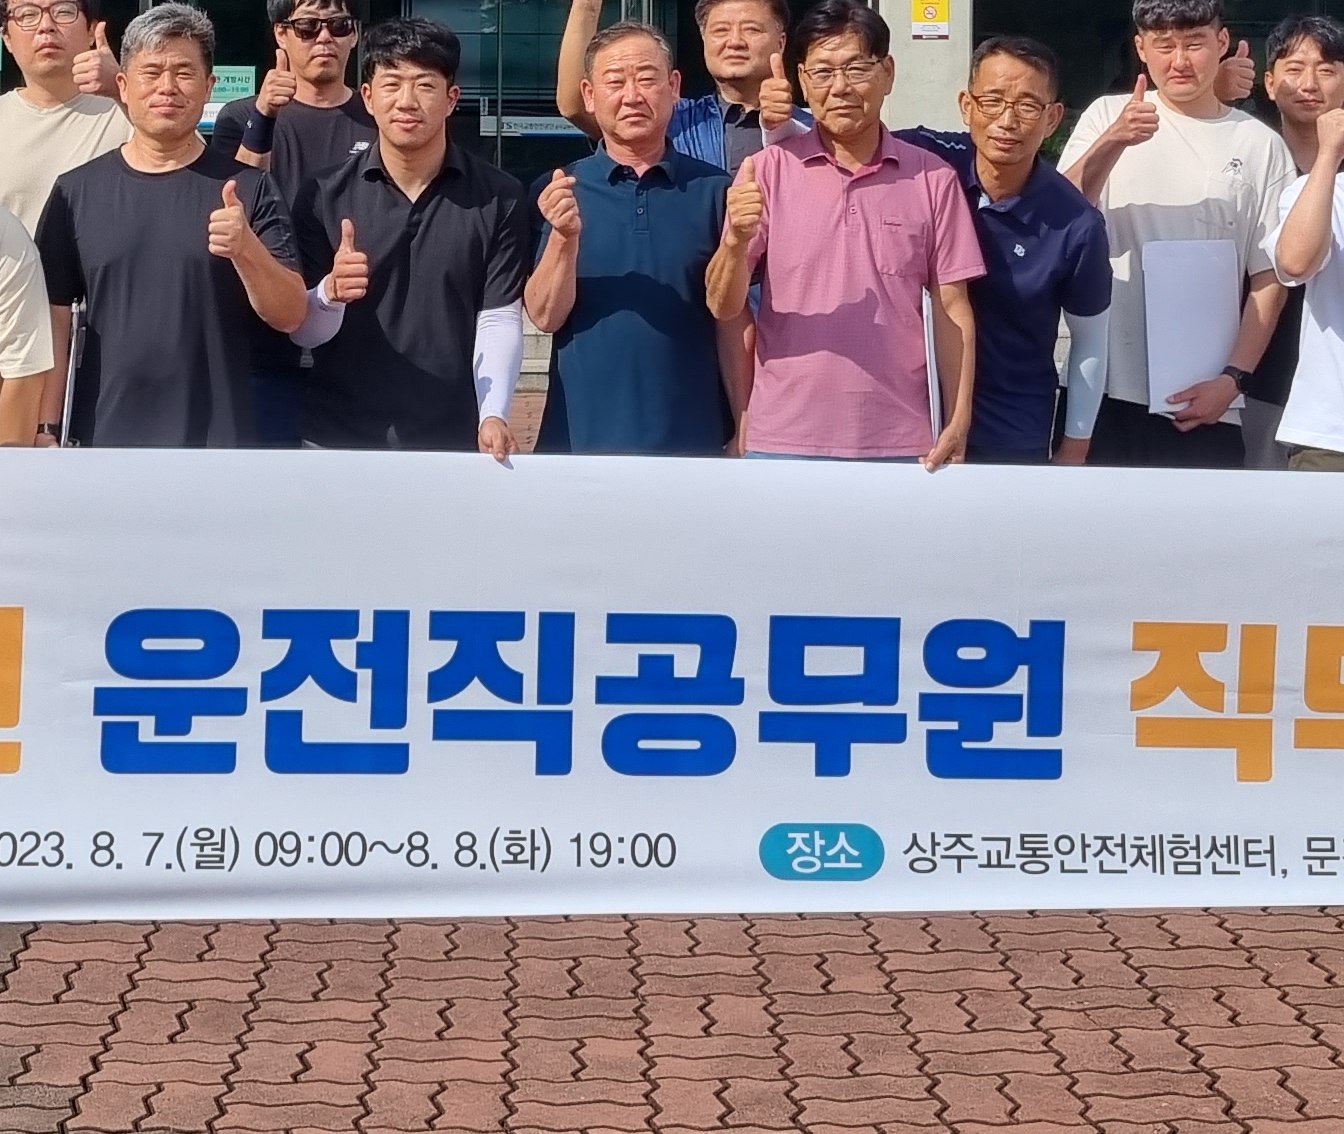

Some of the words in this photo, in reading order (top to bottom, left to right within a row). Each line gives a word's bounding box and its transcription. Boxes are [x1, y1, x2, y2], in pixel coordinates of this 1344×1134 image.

[93, 607, 1067, 781] 운전직공무원
[90, 830, 124, 870] 8.
[141, 825, 241, 873] 7.(월)
[453, 826, 552, 871] 8.(화)
[568, 831, 678, 869] 19:00
[784, 829, 863, 875] 장소
[901, 830, 1288, 880] 상주교통안전체험센터,
